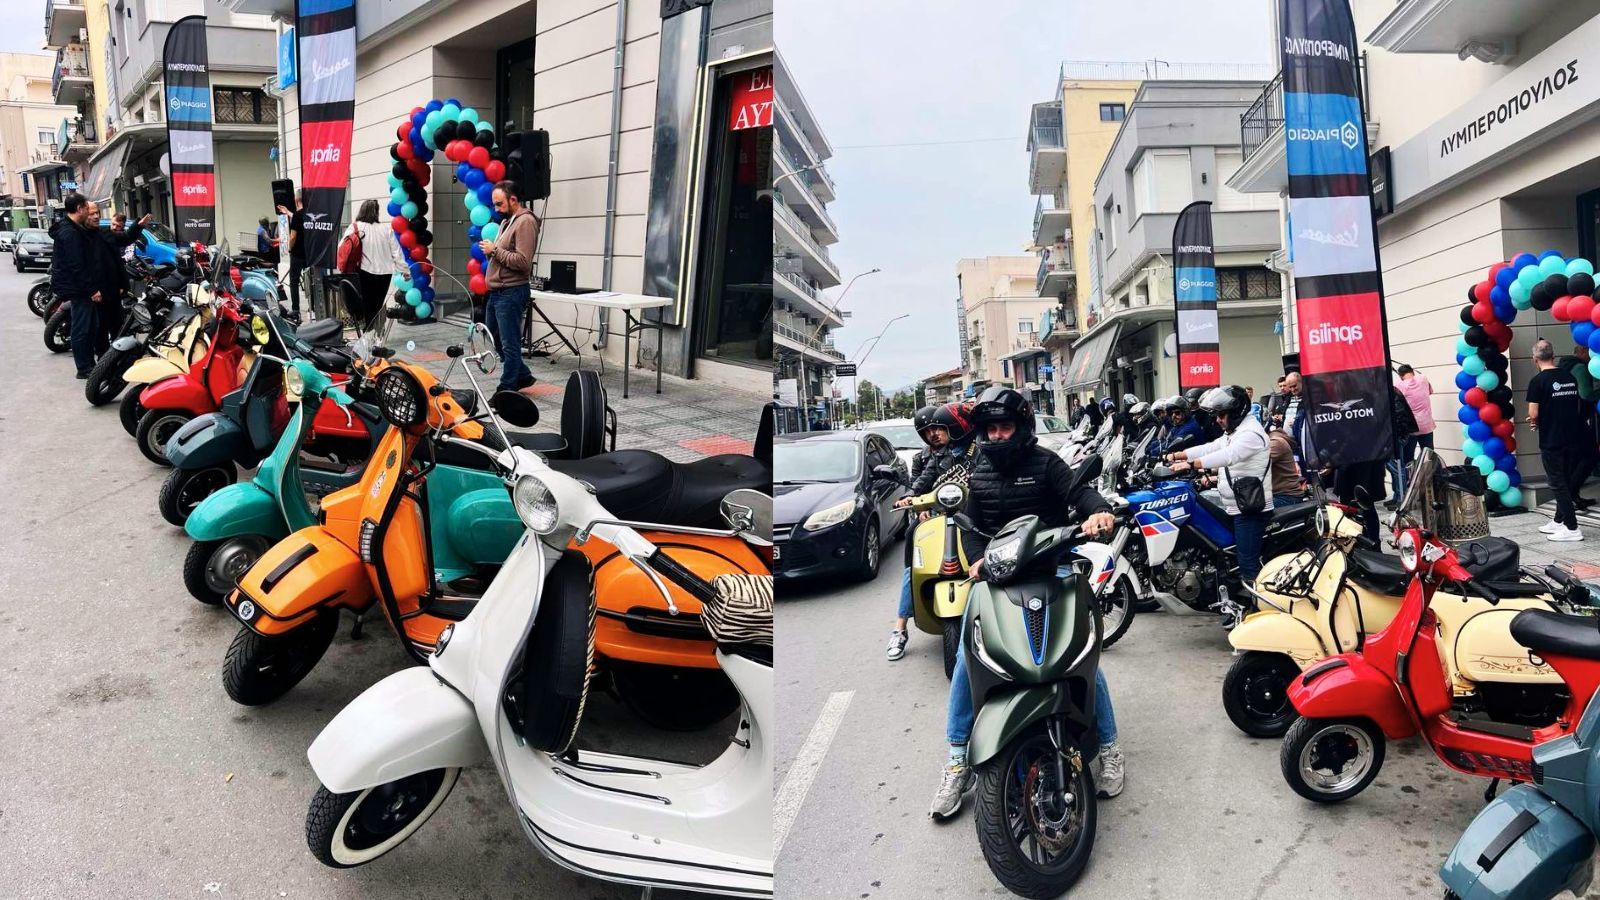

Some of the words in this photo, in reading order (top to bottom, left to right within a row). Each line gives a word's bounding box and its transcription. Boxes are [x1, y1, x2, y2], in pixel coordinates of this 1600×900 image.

[312, 57, 350, 82] Vespa
[1440, 58, 1579, 158] ΛΥΜΠΕΡΟΠΟΥΛΟΣ
[314, 221, 333, 231] GUZZI
[1139, 492, 1189, 511] TUAREG
